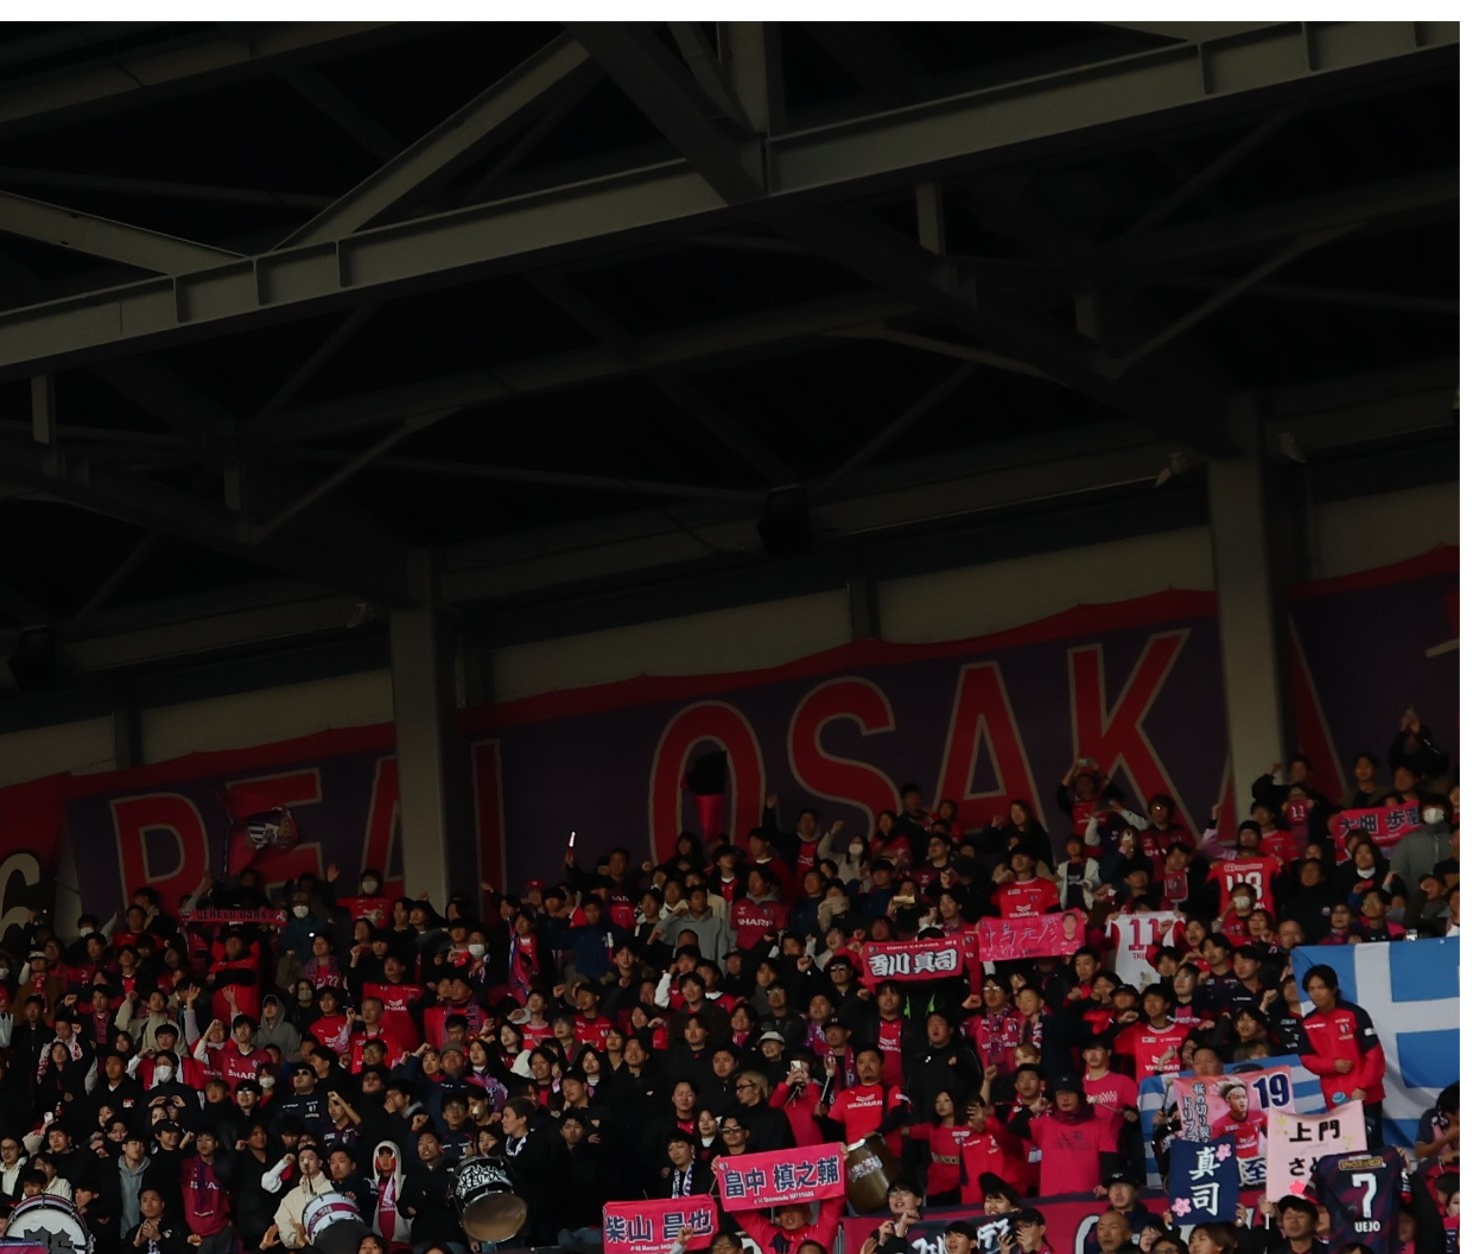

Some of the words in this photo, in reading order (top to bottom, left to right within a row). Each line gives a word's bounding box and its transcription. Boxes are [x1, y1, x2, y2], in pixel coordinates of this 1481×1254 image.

[869, 954, 910, 979] 香川
[915, 949, 958, 975] 真司
[1252, 1072, 1290, 1109] 19
[1289, 1119, 1340, 1143] 上門
[1189, 1146, 1222, 1216] 真司
[1351, 1173, 1377, 1219] 7
[604, 1213, 653, 1245] 柴山
[1354, 1220, 1381, 1232] UEJO
